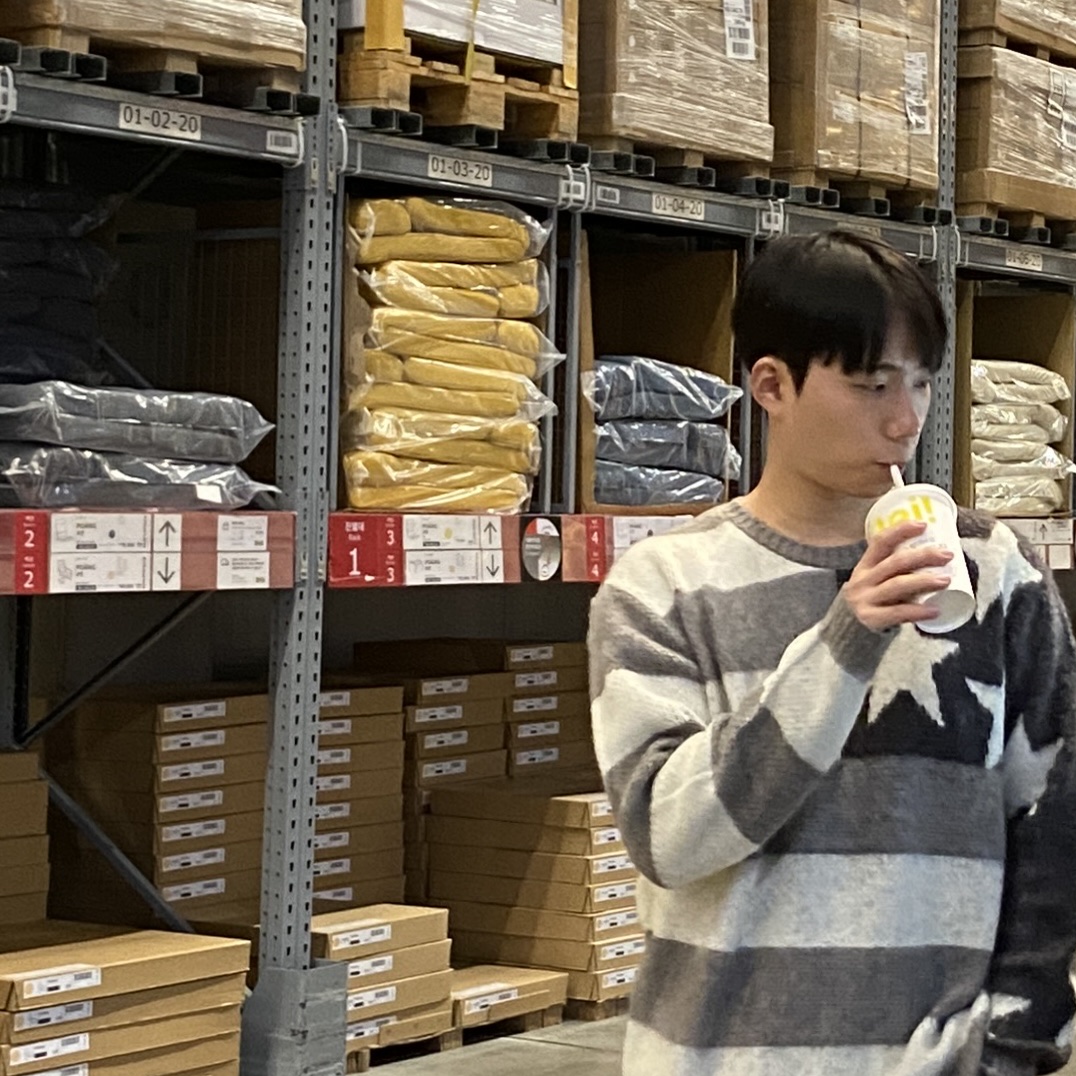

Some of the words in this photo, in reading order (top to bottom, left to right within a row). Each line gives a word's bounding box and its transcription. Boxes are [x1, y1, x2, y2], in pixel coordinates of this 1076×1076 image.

[123, 105, 198, 134] 01-02-20
[431, 156, 490, 181] 01-03-20
[654, 194, 703, 216] 01-04-20
[23, 529, 36, 548] 2
[386, 529, 396, 546] 3
[590, 531, 600, 545] 4
[348, 547, 362, 576] 1
[22, 570, 35, 589] 2
[386, 566, 396, 583] 3
